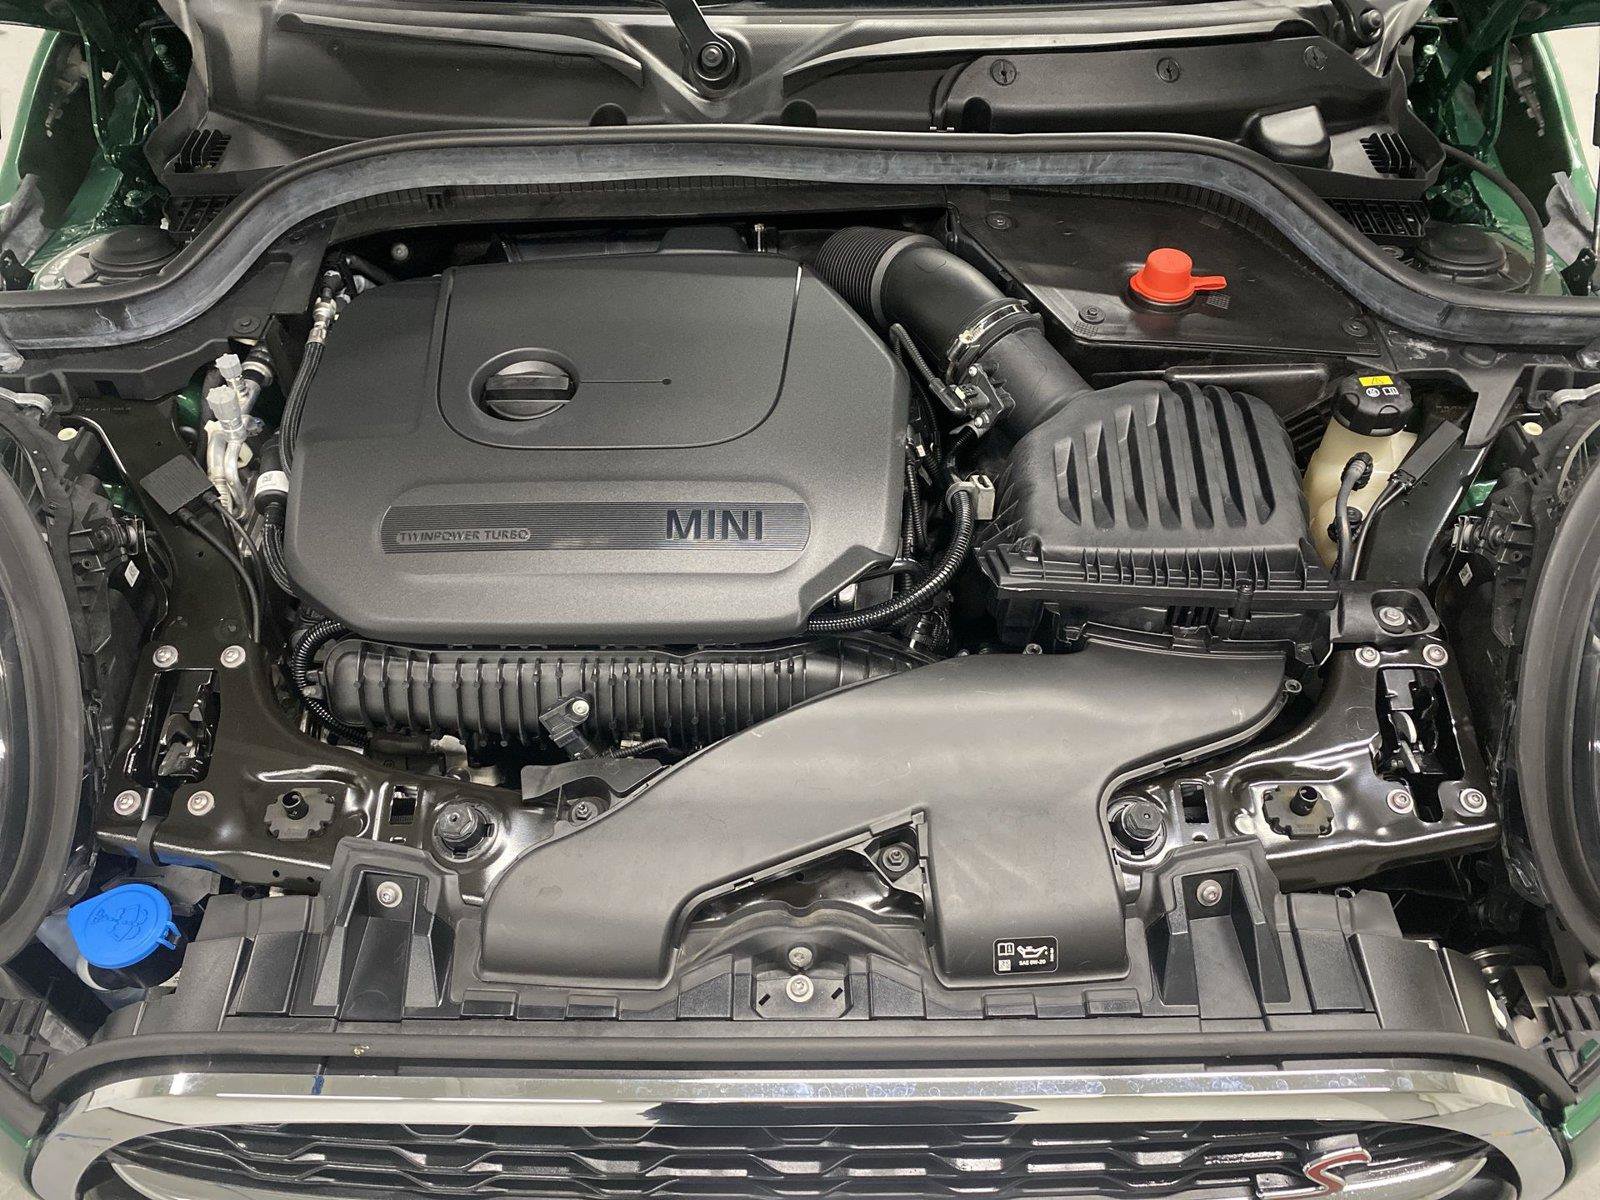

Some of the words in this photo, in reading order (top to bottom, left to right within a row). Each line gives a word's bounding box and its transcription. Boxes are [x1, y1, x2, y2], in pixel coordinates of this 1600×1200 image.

[400, 530, 480, 542] TWINPOWER
[485, 529, 529, 540] TURBO
[666, 509, 763, 540] MINI
